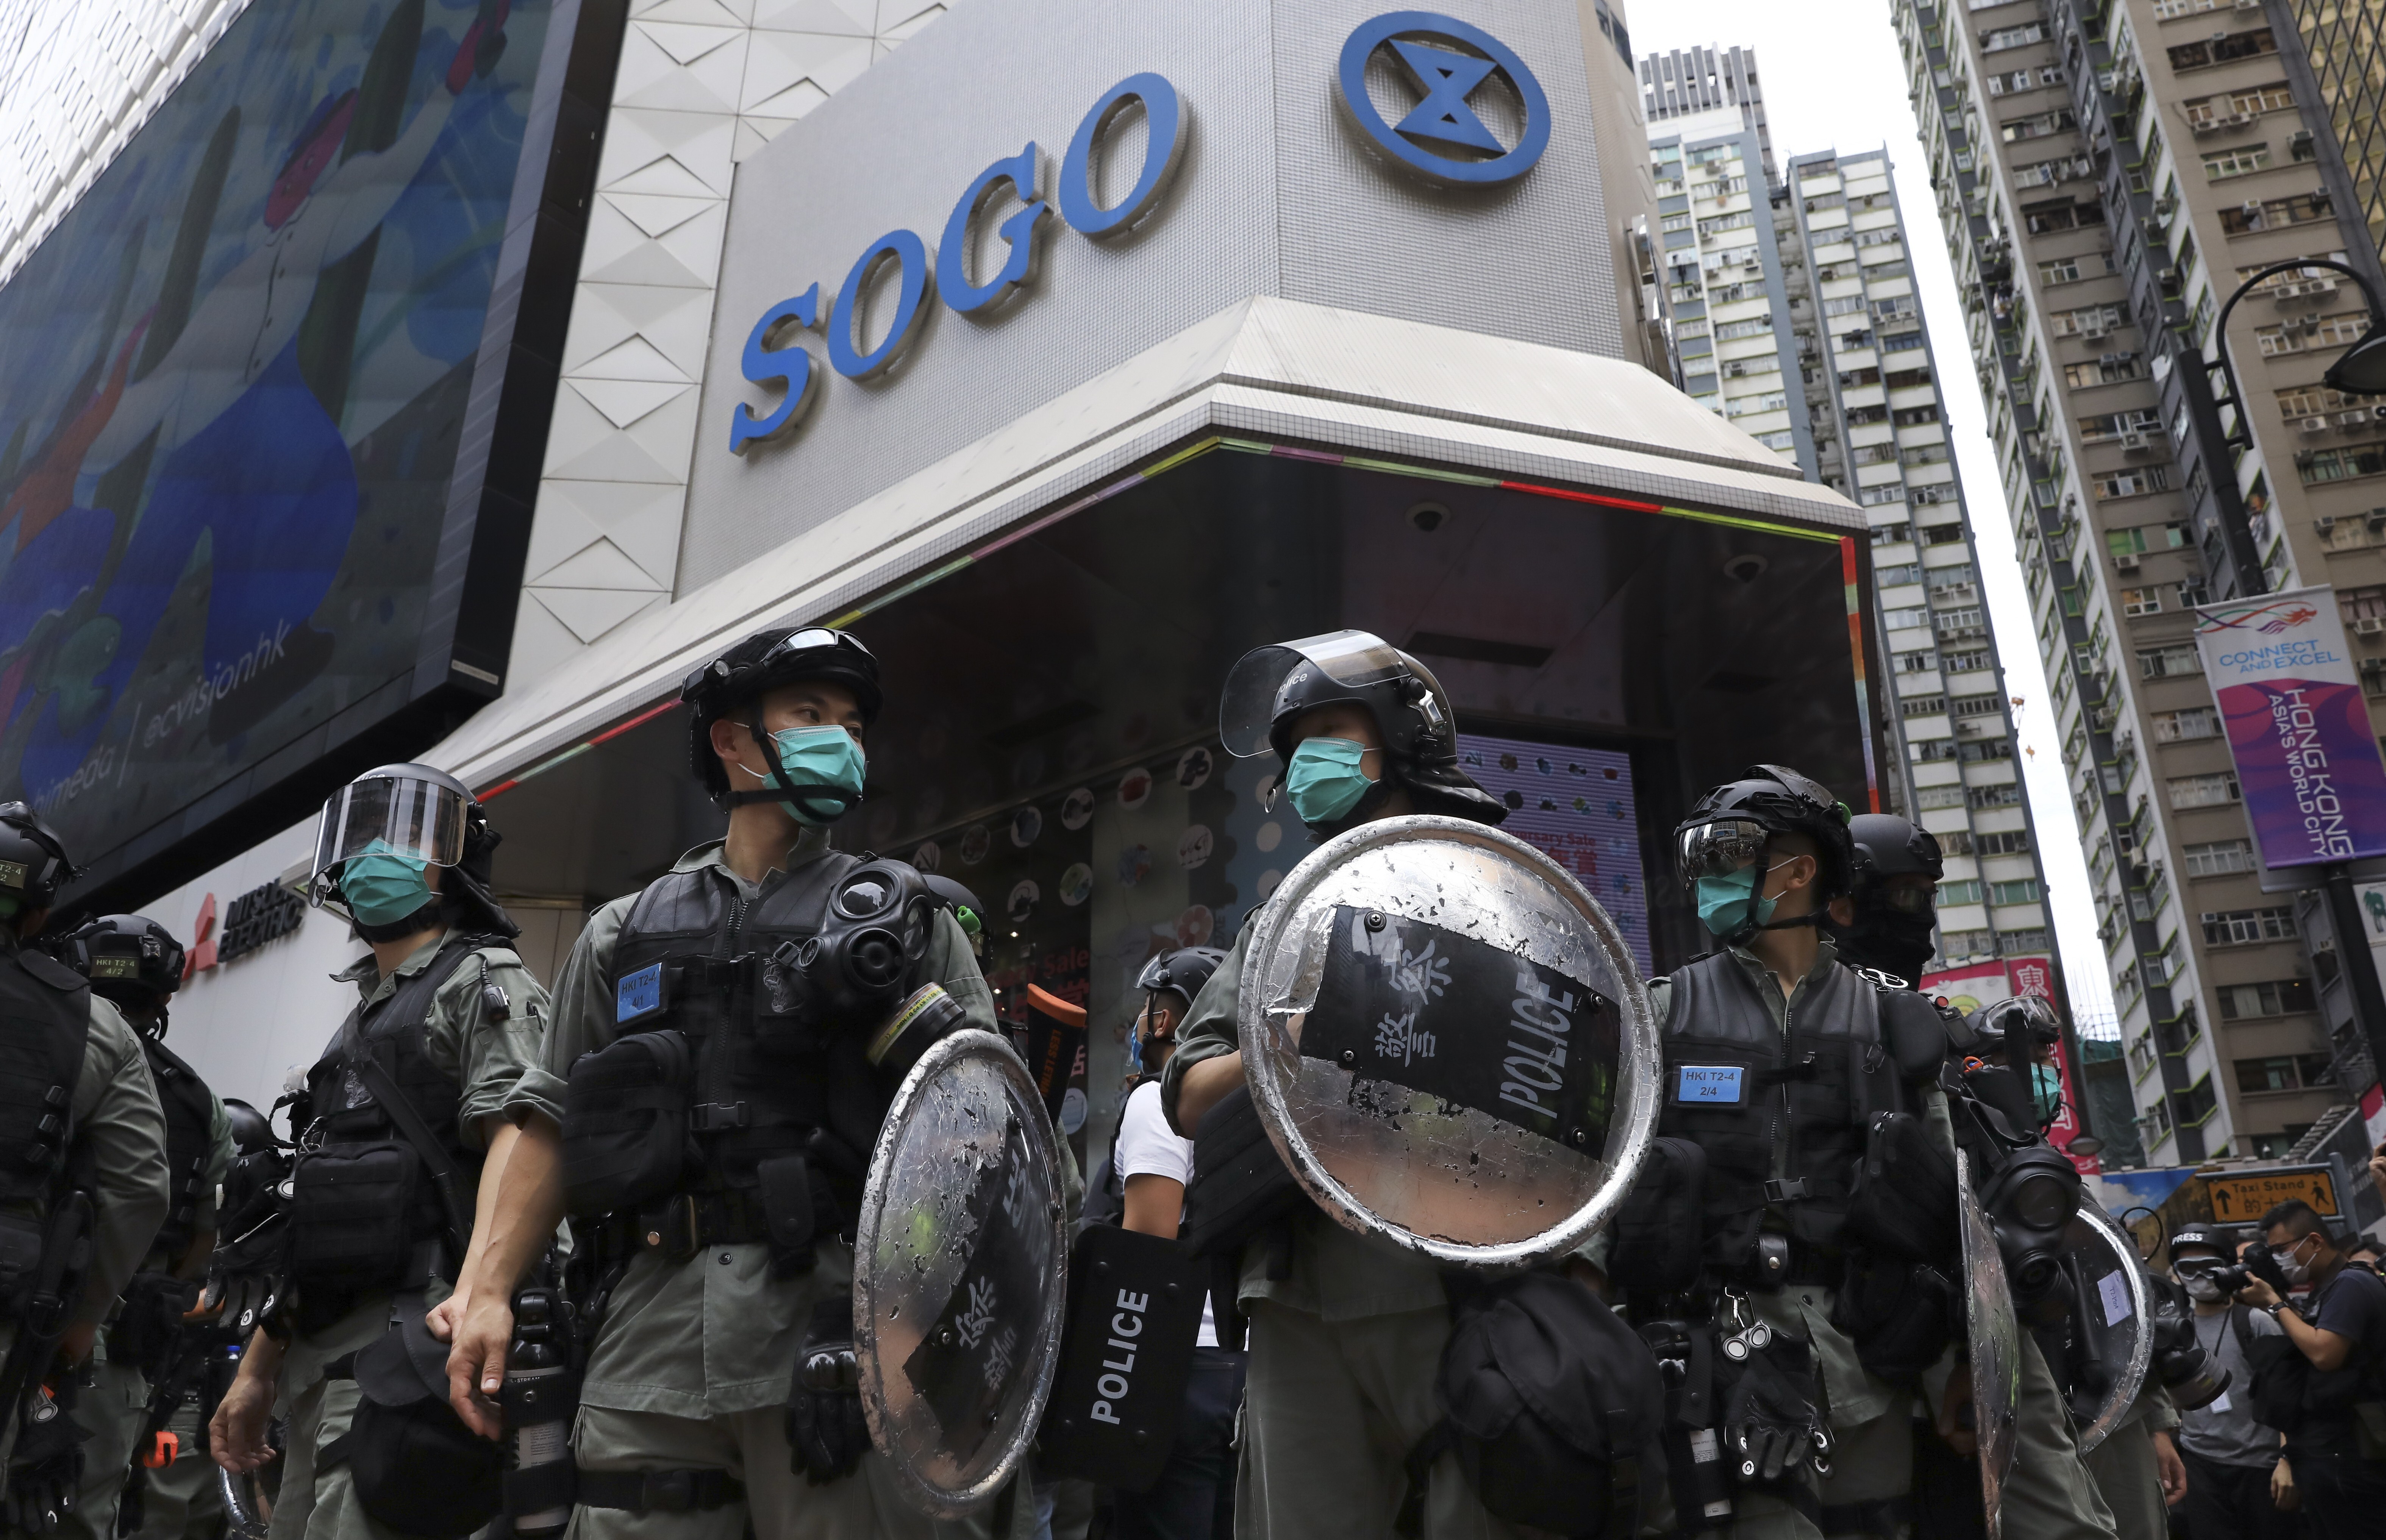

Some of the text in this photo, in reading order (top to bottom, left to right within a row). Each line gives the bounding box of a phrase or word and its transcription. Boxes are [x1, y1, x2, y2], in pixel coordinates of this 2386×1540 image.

[730, 71, 1191, 456] SOGO
[2220, 639, 2318, 667] CONNECT
[2240, 650, 2341, 673] AND EXCEL
[1278, 673, 1308, 693] olice
[2268, 694, 2328, 857] ASIA'S WORLD CITY
[2285, 688, 2354, 857] HONG KONG
[1567, 832, 1596, 846] Sale
[217, 898, 305, 962] ELECTRIC
[622, 971, 656, 994] HKI T2-4
[2016, 964, 2048, 996] 東
[632, 995, 643, 1007] 4/1
[1374, 939, 1453, 1067] 警察
[896, 1018, 907, 1029] NBC
[1048, 1029, 1063, 1058] LESS
[1499, 971, 1575, 1119] POLICE
[1686, 1071, 1734, 1082] HKI T2-4
[1700, 1087, 1717, 1096] 2/4
[2231, 1179, 2305, 1193] Taxi Stand
[2244, 1196, 2296, 1213] 的士
[2172, 1232, 2203, 1246] PRESS
[955, 1276, 1017, 1391] 警察
[1091, 1288, 1149, 1425] POLICE
